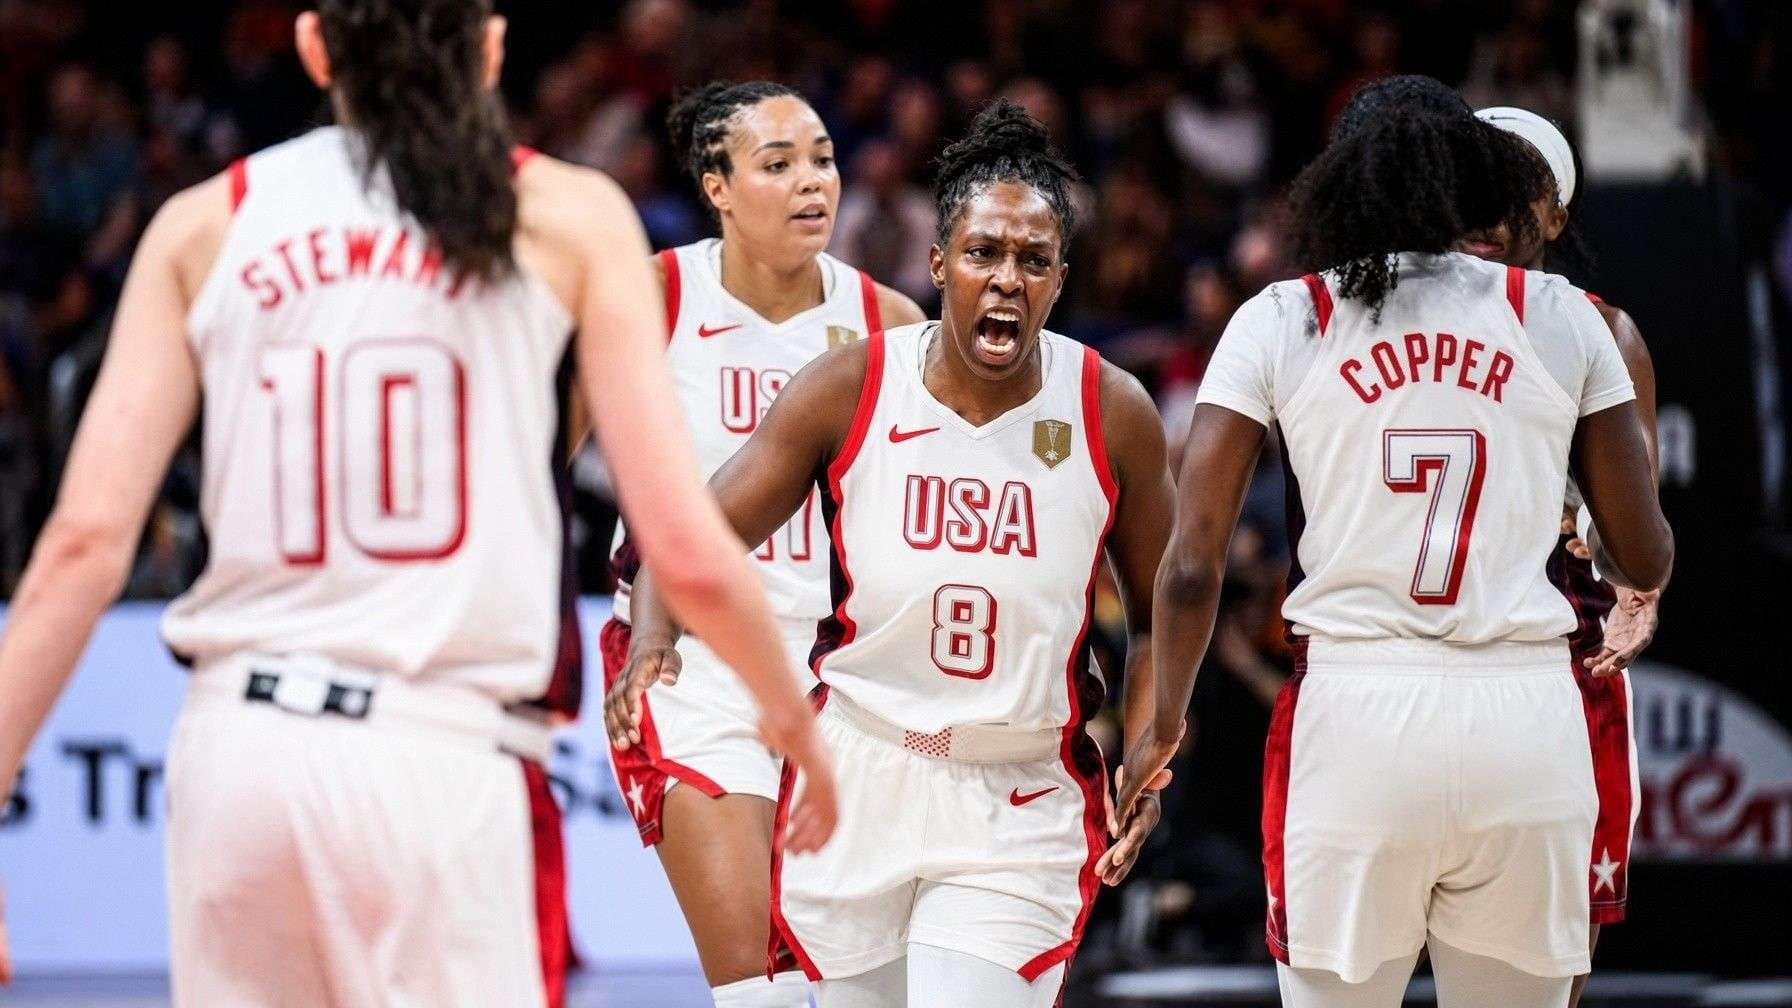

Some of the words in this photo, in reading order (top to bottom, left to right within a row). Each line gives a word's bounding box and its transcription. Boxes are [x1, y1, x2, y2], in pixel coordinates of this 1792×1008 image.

[720, 366, 793, 434] US
[1339, 332, 1515, 404] COPPER
[257, 337, 468, 566] 10
[903, 474, 1038, 558] USA
[1382, 428, 1487, 606] 7
[930, 583, 998, 681] 8
